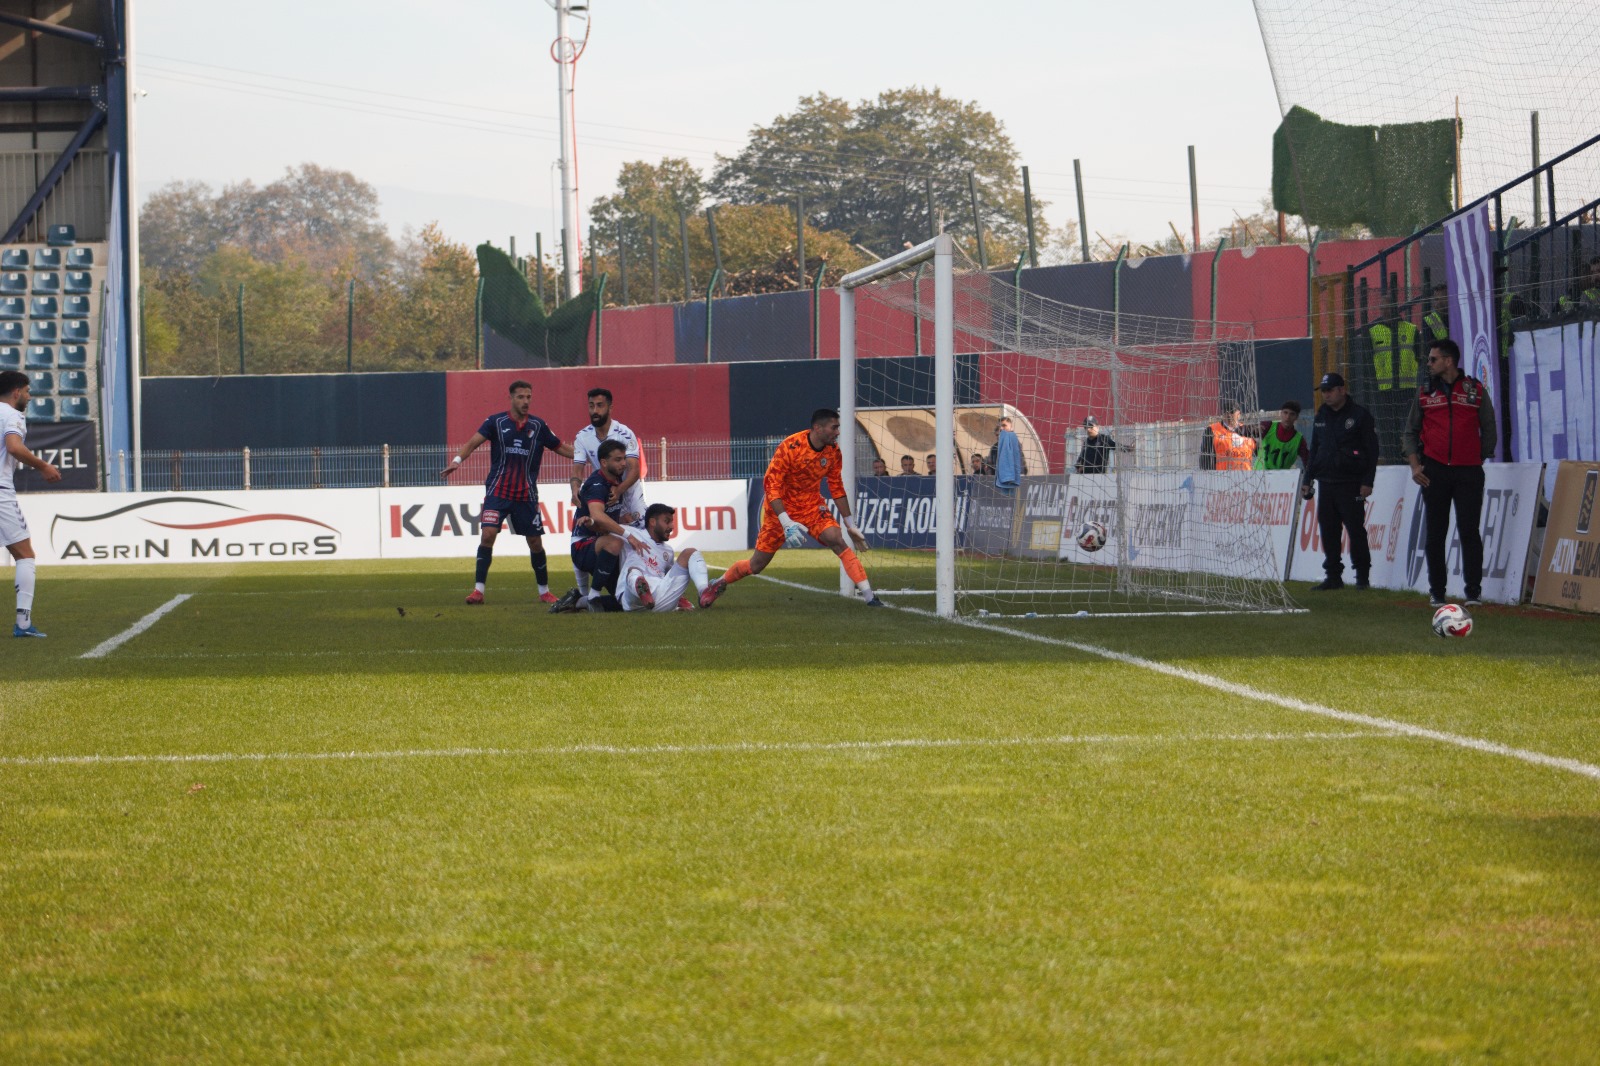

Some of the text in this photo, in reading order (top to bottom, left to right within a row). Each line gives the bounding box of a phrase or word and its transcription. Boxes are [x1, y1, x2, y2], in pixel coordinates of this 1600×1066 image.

[1457, 396, 1468, 404] POL
[18, 448, 88, 470] ZEL
[856, 491, 903, 534] ÜZCE
[61, 536, 338, 559] ASRIN MOTORS
[1561, 579, 1583, 601] GLOBAL
